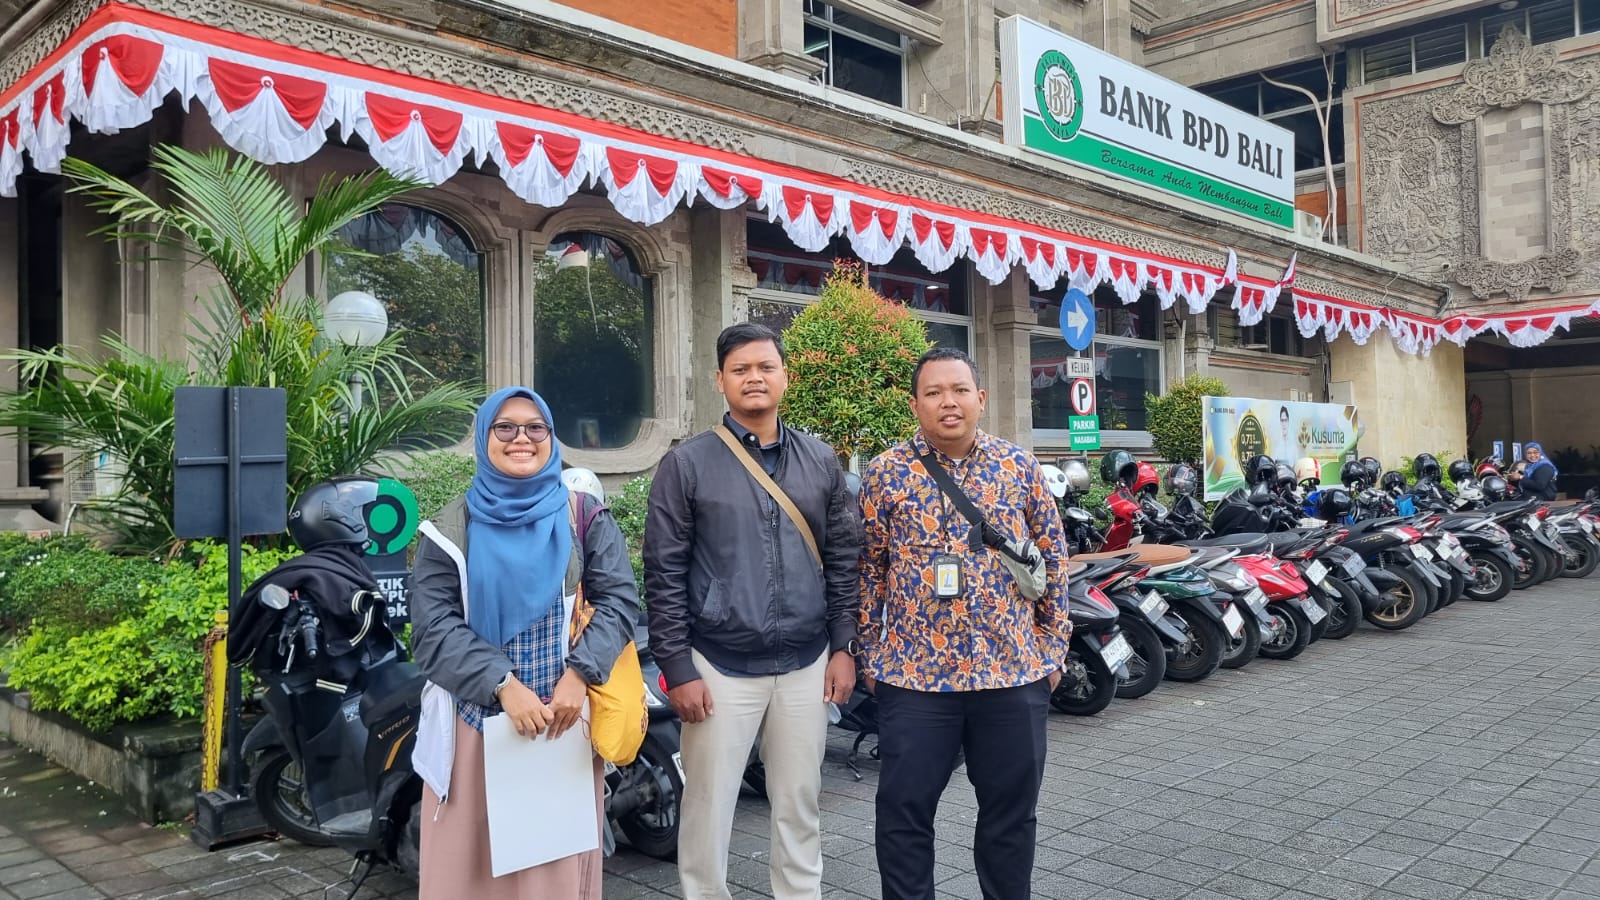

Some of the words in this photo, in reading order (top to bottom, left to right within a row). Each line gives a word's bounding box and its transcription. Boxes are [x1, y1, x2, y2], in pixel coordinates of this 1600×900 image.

[1098, 75, 1173, 140] BANK
[1182, 109, 1230, 159] BPD
[1237, 132, 1284, 180] BALI
[1101, 148, 1156, 178] Bersama
[1160, 171, 1193, 191] Anda
[1197, 180, 1259, 212] Membangun
[1263, 203, 1284, 219] Bali
[1071, 362, 1090, 374] KELUAR
[1078, 383, 1088, 411] P
[1073, 420, 1095, 430] PARKIR
[1311, 427, 1345, 444] Kusuma
[377, 577, 404, 591] TIK
